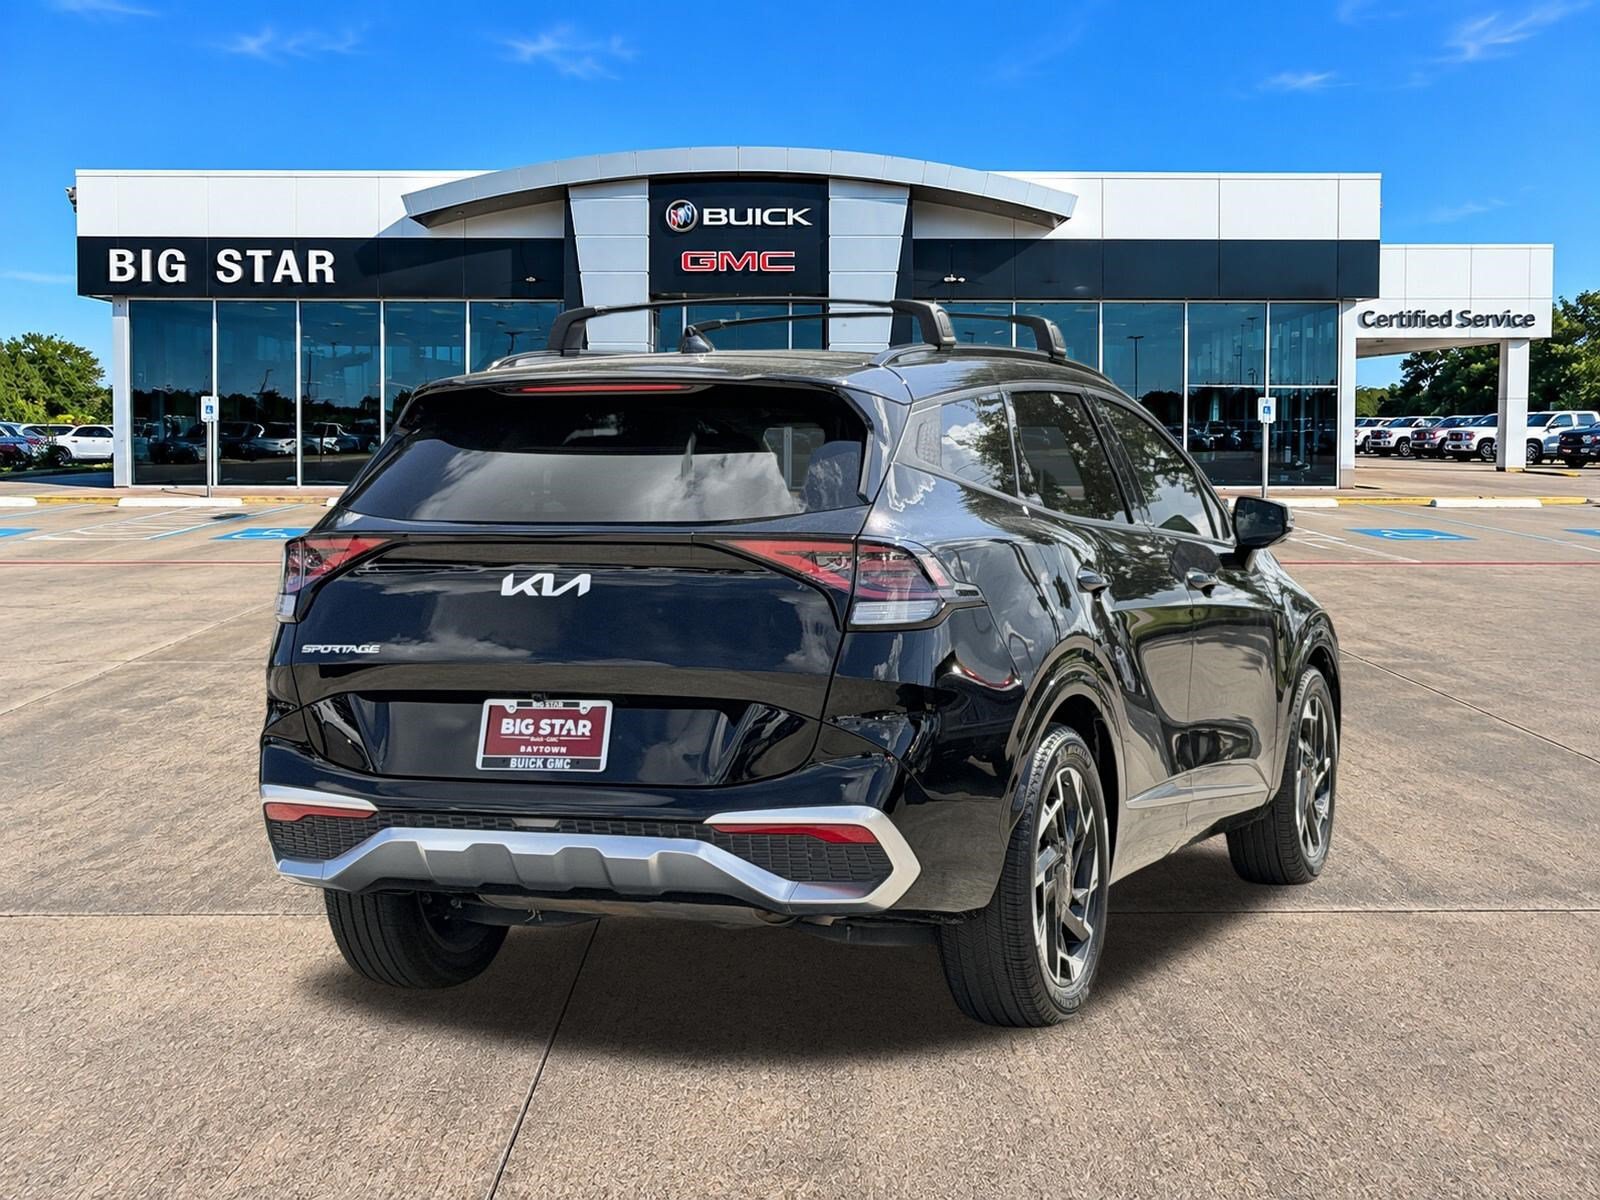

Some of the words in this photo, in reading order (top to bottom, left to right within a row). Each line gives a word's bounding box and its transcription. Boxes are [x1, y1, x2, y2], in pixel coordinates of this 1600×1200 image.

[702, 208, 813, 226] BUICK
[108, 249, 187, 283] BIG
[216, 249, 336, 283] STAR
[681, 251, 796, 272] GMC
[1359, 310, 1452, 329] Certified
[1456, 310, 1536, 329] Service
[501, 573, 591, 597] KIA
[301, 644, 380, 654] SPORTAGE
[500, 718, 535, 735] BIG
[538, 719, 592, 736] STAR
[519, 745, 567, 754] BAYTOWN
[509, 758, 544, 769] BUICK
[546, 759, 572, 769] GMC
